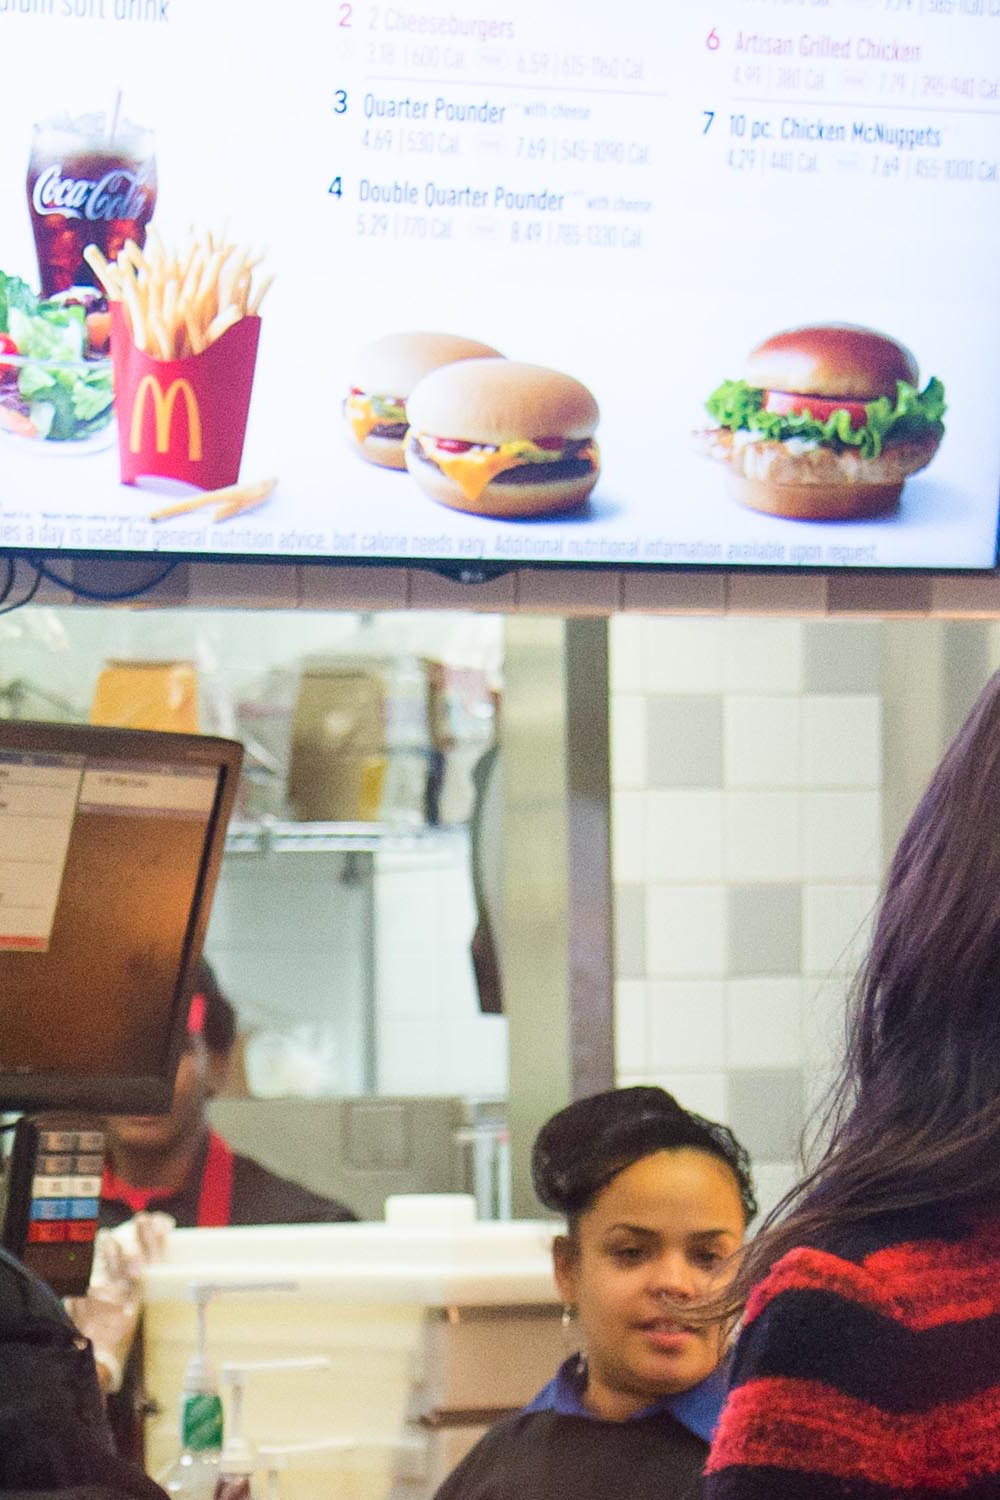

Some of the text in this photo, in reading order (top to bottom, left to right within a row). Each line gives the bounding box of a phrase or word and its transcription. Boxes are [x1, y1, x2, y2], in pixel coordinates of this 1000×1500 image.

[337, 2, 353, 28] 2
[368, 6, 517, 42] 2 Cheeseburgers
[706, 27, 720, 51] 6
[735, 30, 921, 62] Artisan Grilled Chicken
[332, 89, 348, 115] 3
[364, 92, 591, 124] Quarter Pounder with cheese
[702, 111, 715, 135] 7
[729, 114, 746, 138] 10
[780, 117, 845, 143] Chicken
[852, 120, 942, 151] McNuggets
[327, 174, 344, 200] 4
[359, 178, 652, 212] Double Quarter Pounder with cheese
[357, 213, 387, 238] 5.29
[39, 522, 65, 548] day
[70, 525, 82, 545] is
[87, 524, 122, 545] used
[126, 524, 148, 546] for
[152, 526, 206, 551] general
[211, 527, 274, 549] nutrition
[333, 531, 356, 552] but
[360, 531, 408, 553] calorie
[412, 533, 453, 555] needs
[494, 534, 563, 557] Additional
[568, 536, 639, 559] nutritional
[644, 537, 722, 561] information
[726, 540, 788, 562] available
[791, 544, 823, 565] upon
